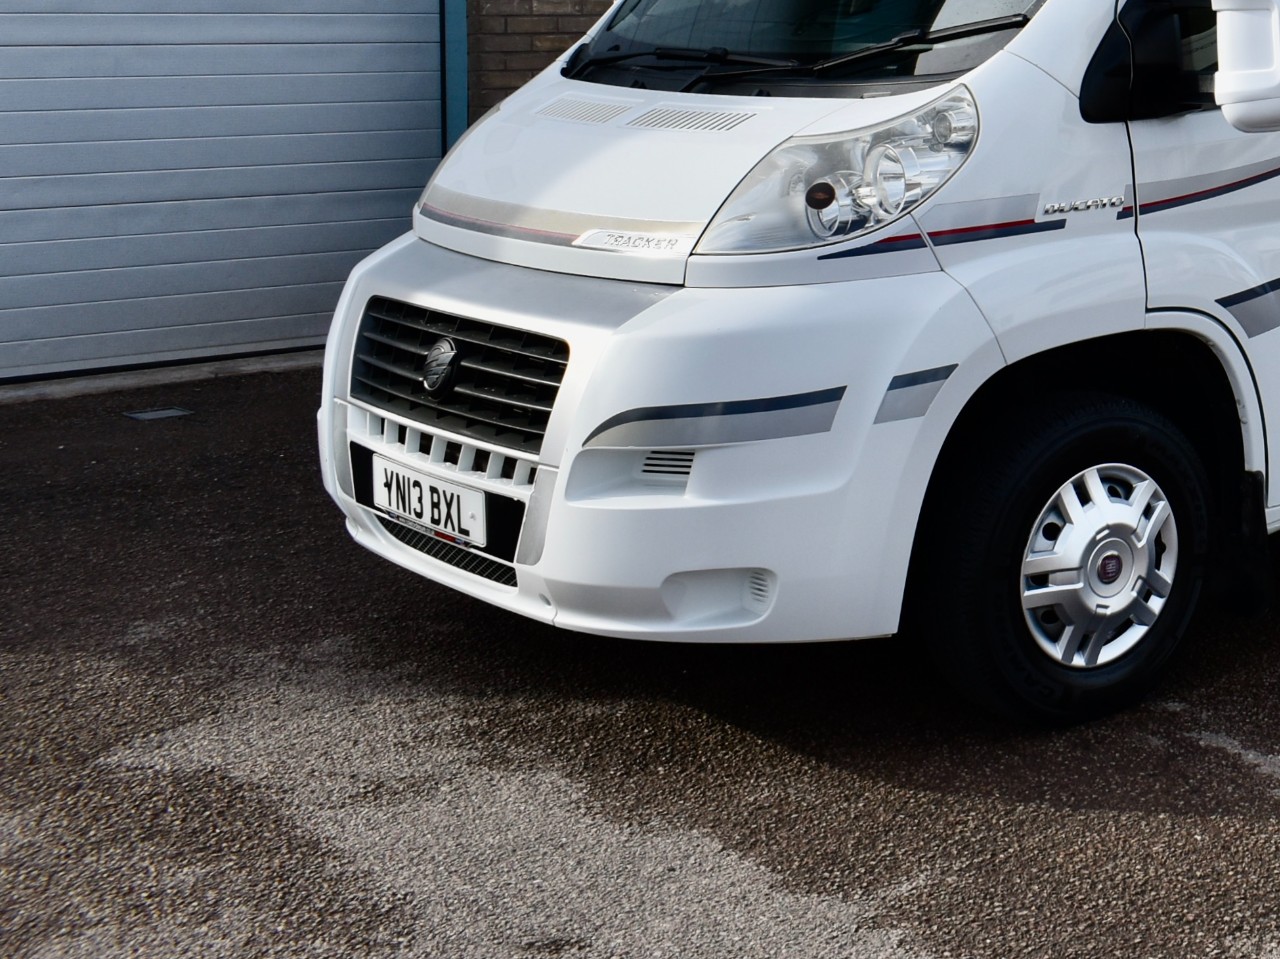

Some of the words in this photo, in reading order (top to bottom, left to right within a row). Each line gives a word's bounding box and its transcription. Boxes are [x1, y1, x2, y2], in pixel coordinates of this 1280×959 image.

[1042, 195, 1125, 216] DUCATO
[604, 233, 679, 251] TRACKER
[383, 467, 424, 520] YN13
[429, 484, 470, 537] BXL
